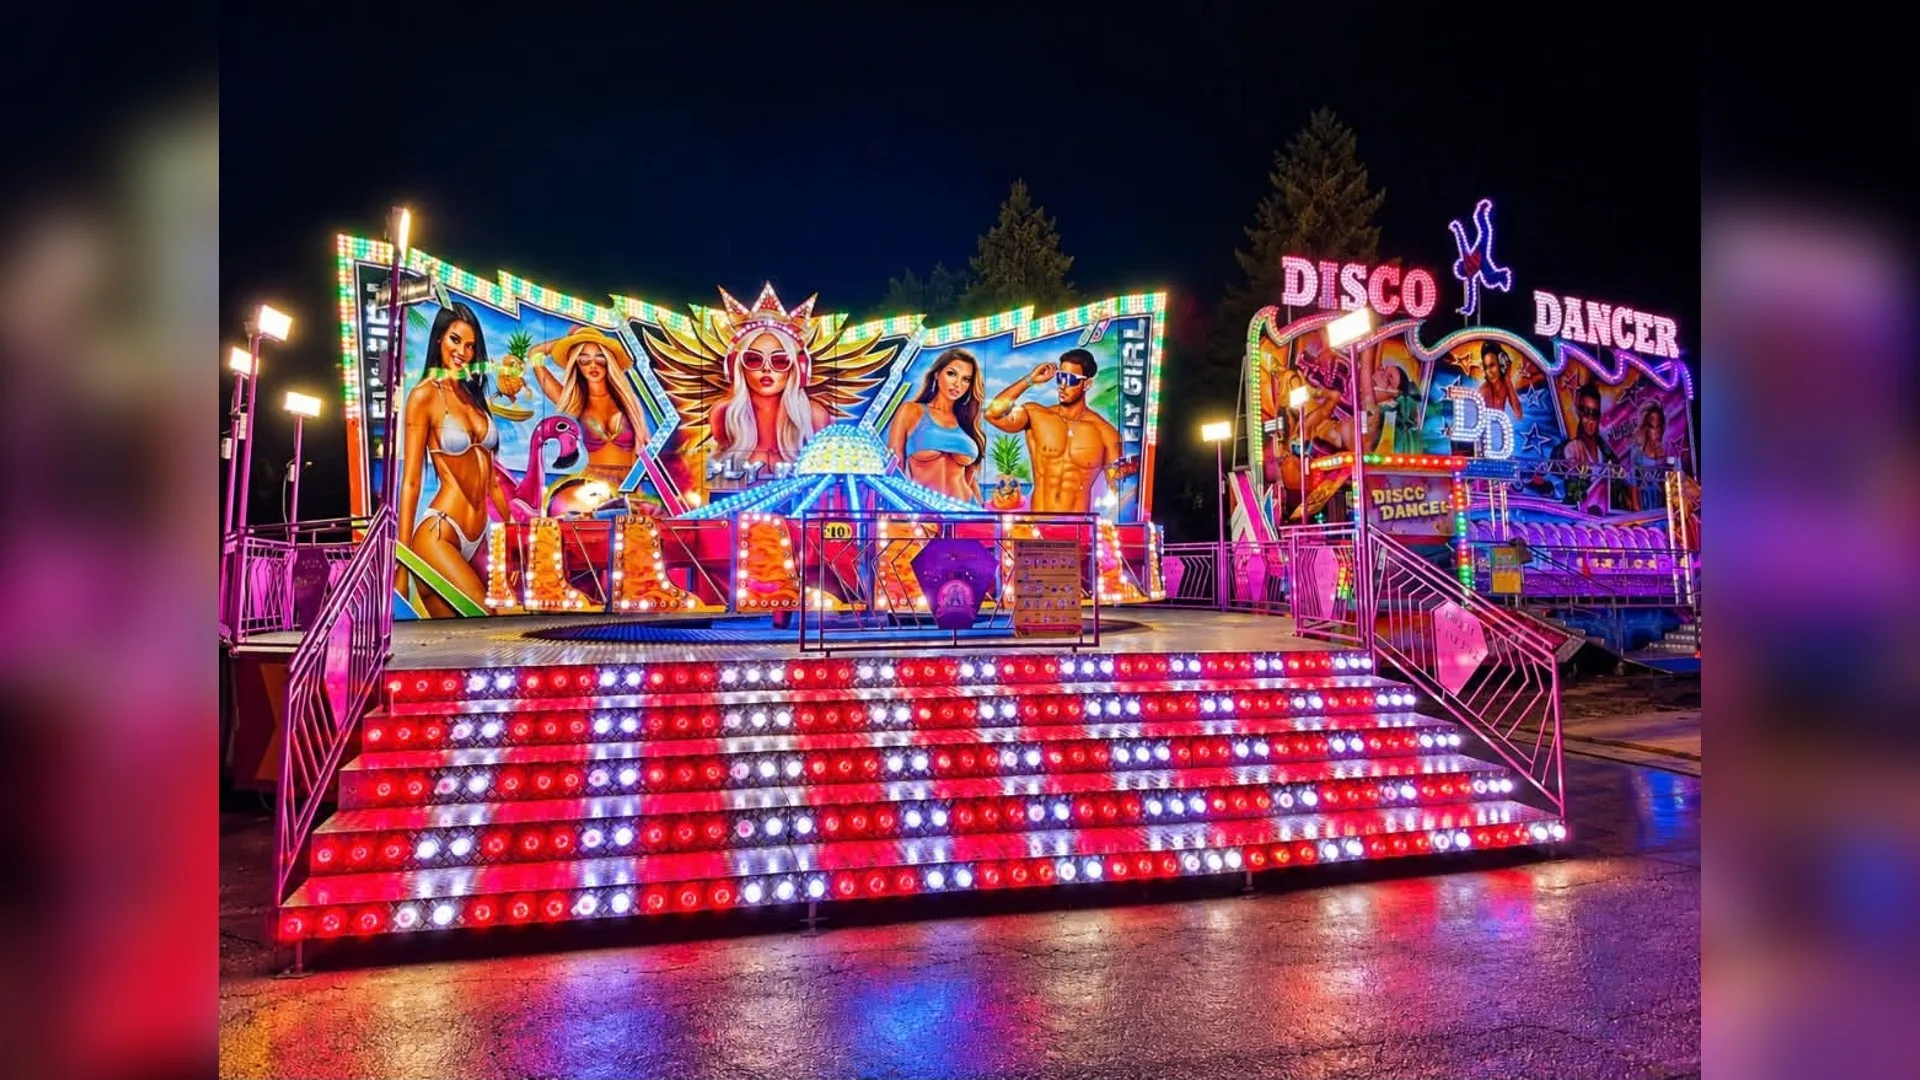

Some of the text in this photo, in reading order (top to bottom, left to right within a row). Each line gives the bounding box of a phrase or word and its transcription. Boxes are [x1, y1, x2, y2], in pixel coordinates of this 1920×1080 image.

[1282, 256, 1679, 358] DISCO DANCER
[1122, 318, 1146, 443] FLY GIRL
